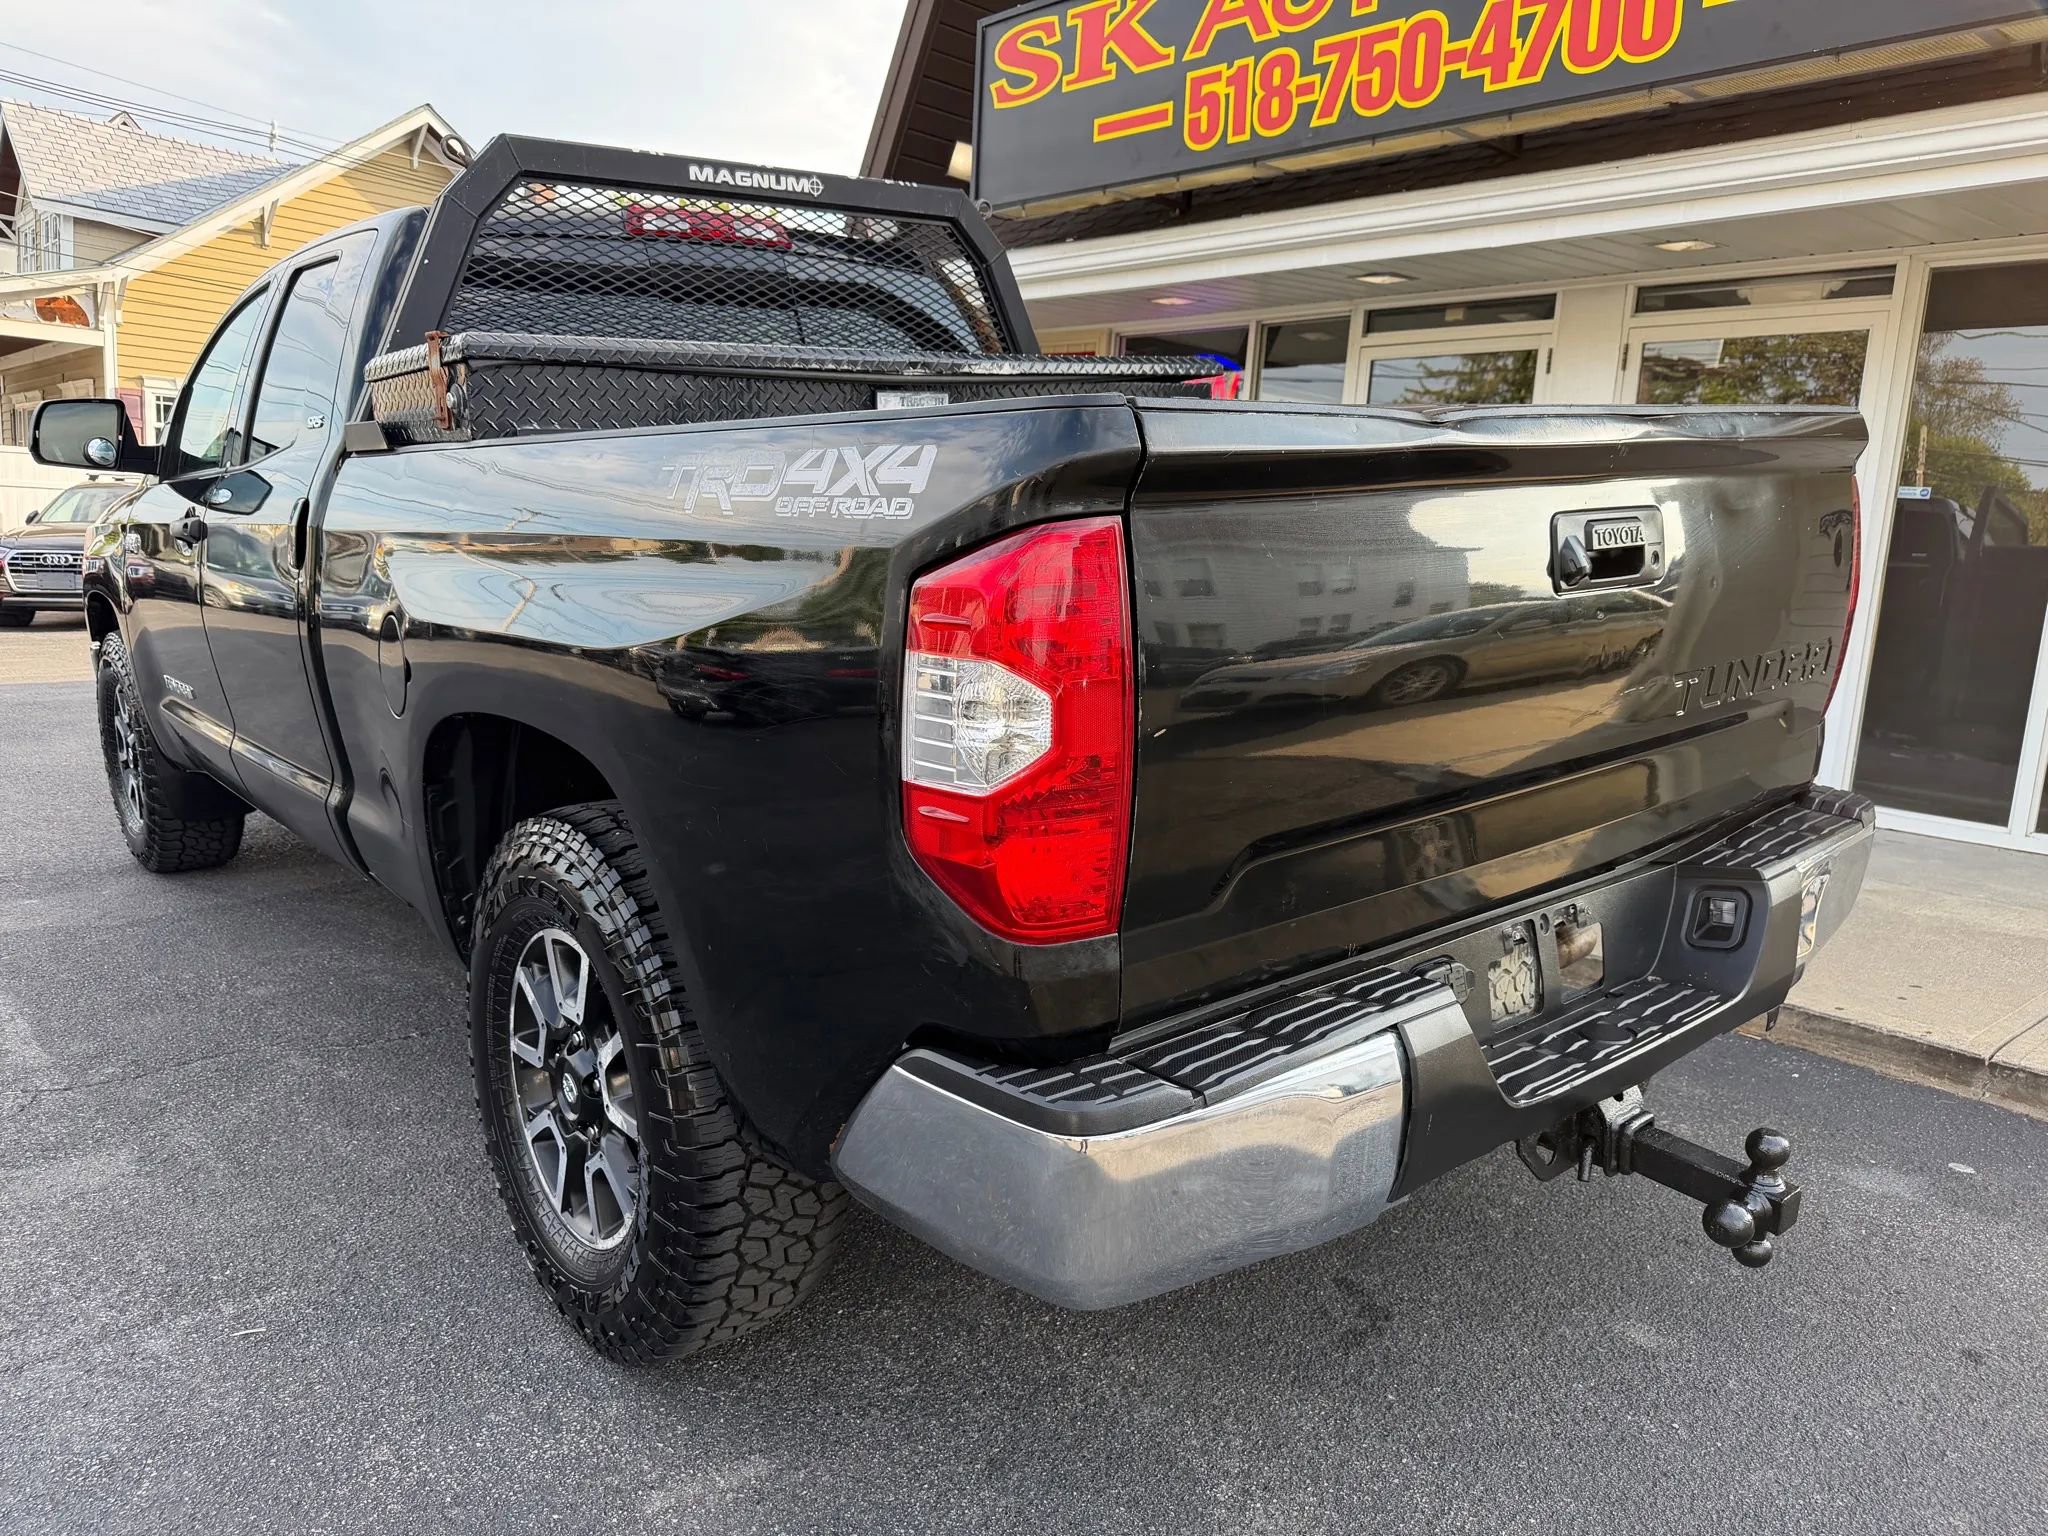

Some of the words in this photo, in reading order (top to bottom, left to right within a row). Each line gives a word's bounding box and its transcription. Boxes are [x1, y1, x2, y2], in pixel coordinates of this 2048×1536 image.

[989, 0, 1176, 109] SK
[688, 163, 809, 193] MAGNUM
[661, 450, 786, 515] TRD
[783, 444, 938, 496] 4X4
[829, 496, 915, 520] ROAD
[1595, 526, 1645, 547] TOYOTA
